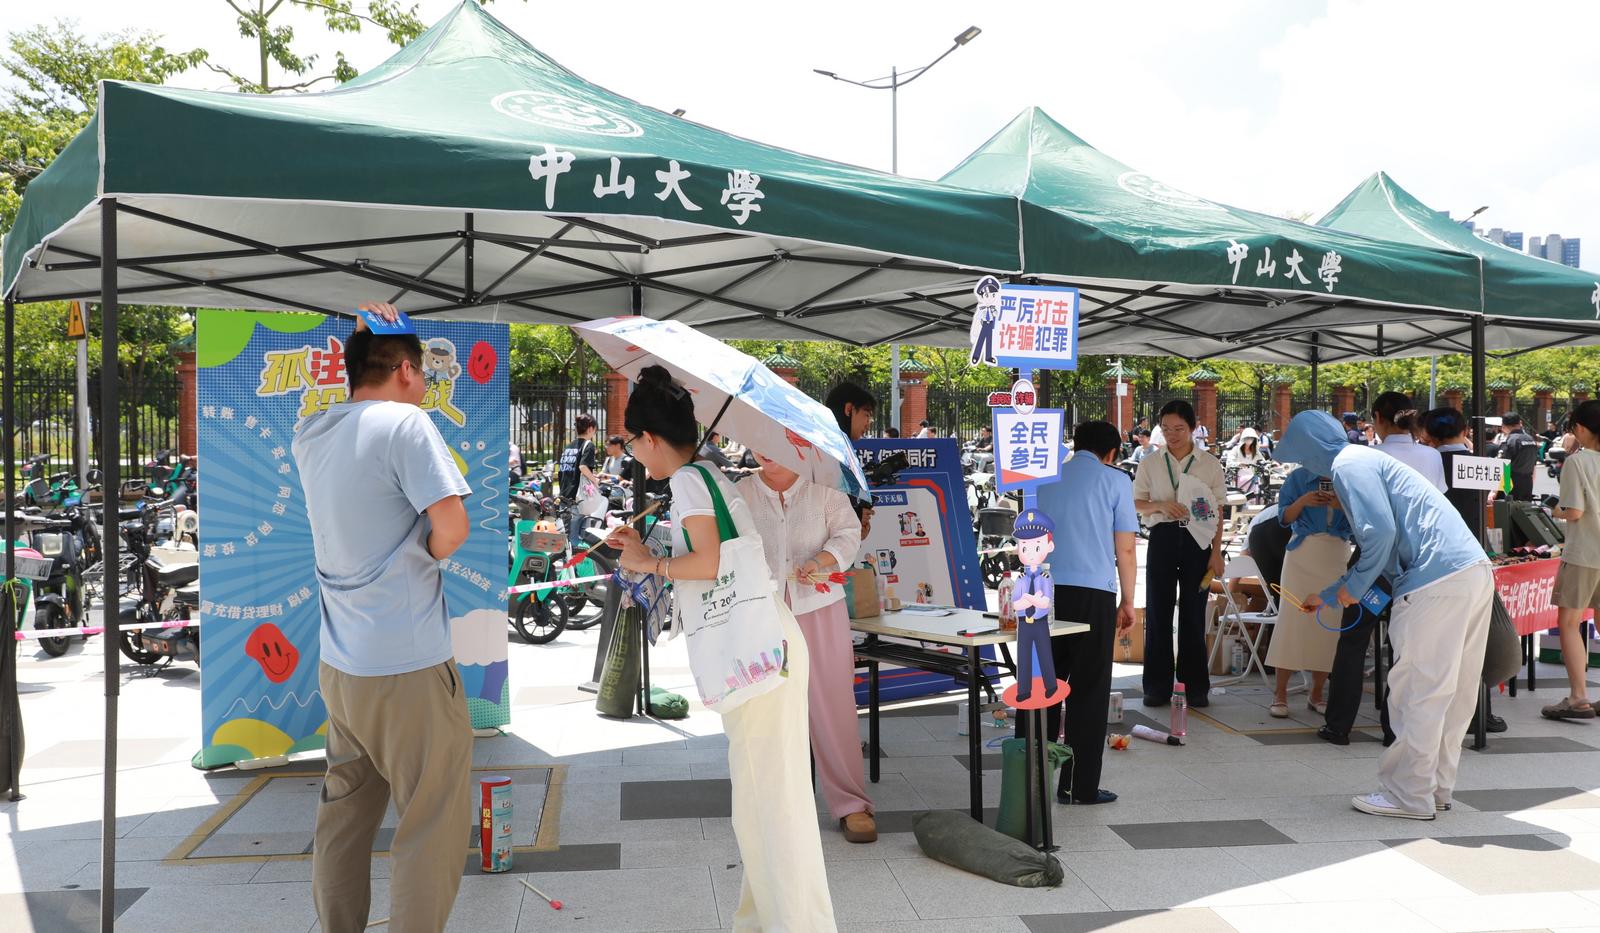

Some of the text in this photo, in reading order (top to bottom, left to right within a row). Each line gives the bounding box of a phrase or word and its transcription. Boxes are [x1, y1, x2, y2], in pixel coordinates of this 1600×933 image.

[528, 144, 765, 225] 中山大學
[1226, 240, 1342, 292] 中山大學
[998, 296, 1068, 325] 严厉打击
[999, 324, 1068, 352] 诈骗犯罪
[1010, 421, 1048, 444] 全民
[1010, 446, 1049, 470] 参与
[1457, 463, 1501, 482] 出口兑礼品
[199, 599, 283, 620] 冒充借贷理财
[1495, 575, 1559, 619] 行光明支行反
